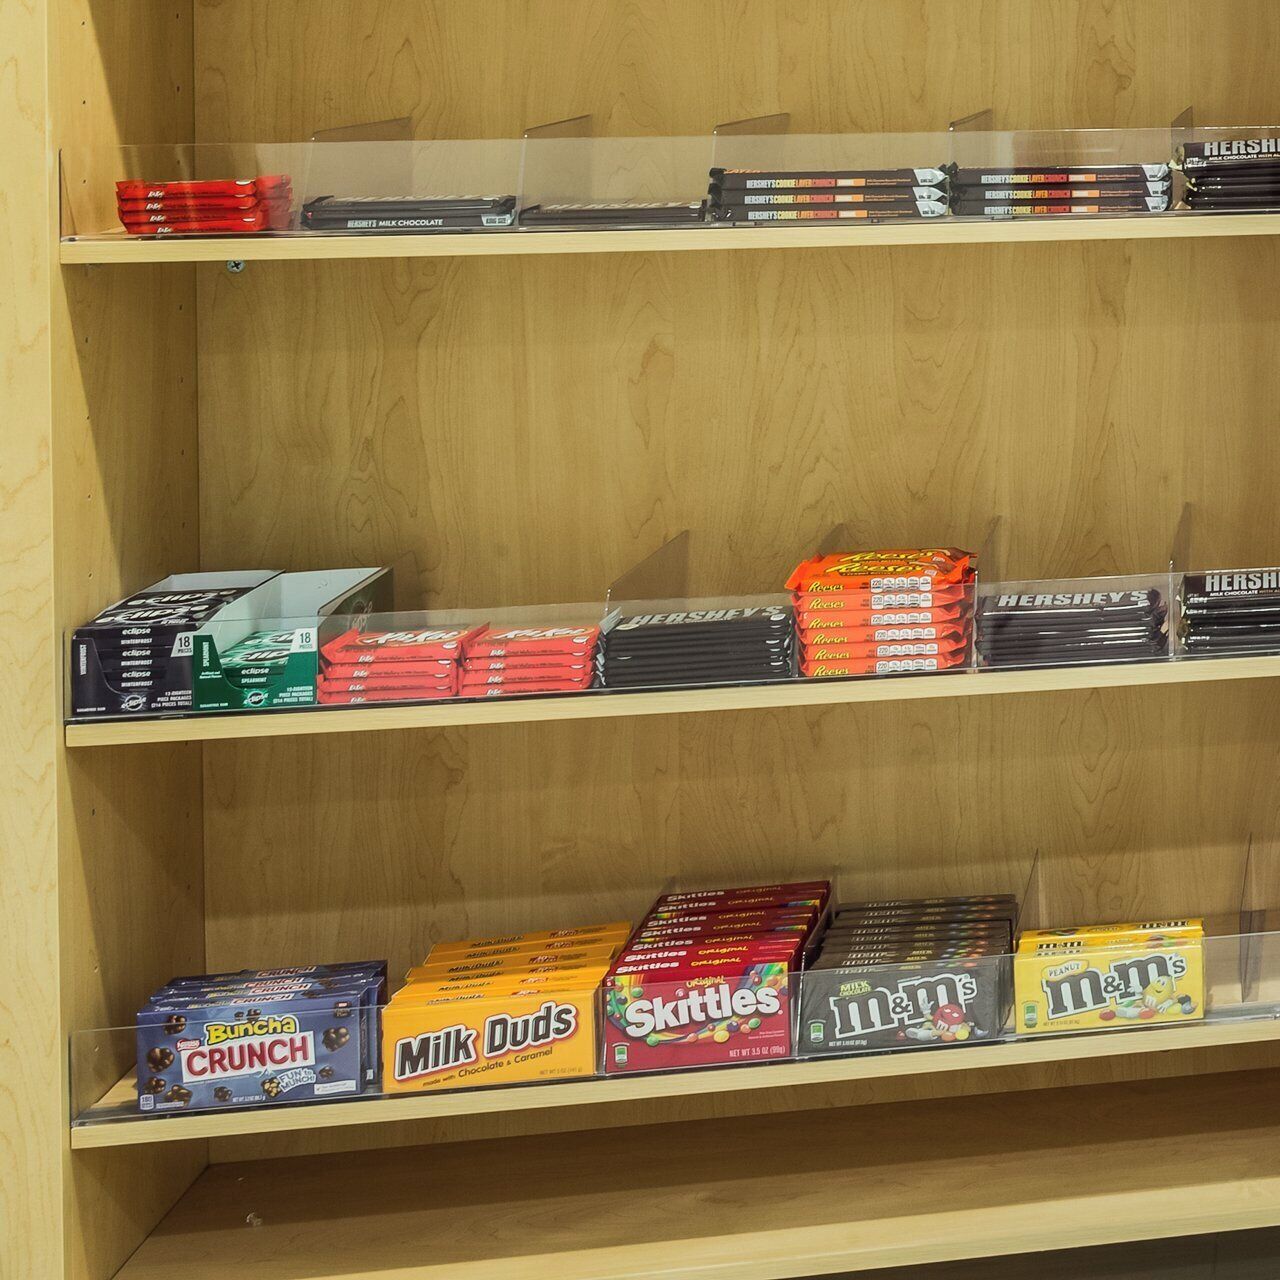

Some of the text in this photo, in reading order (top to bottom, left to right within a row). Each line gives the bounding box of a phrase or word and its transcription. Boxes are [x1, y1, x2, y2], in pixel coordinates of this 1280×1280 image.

[998, 591, 1148, 607] HERSHEY'S
[122, 627, 151, 636] eclipse
[300, 632, 311, 644] 18
[178, 636, 191, 648] 18
[122, 649, 151, 657] eclipse
[624, 950, 687, 962] Skittles
[616, 961, 679, 974] Skittles
[1049, 962, 1080, 977] PEANUT
[841, 981, 869, 991] MILK
[1042, 953, 1187, 1019] m&m's
[625, 986, 780, 1038] Skittles
[830, 973, 977, 1038] m&m's
[207, 1015, 297, 1044] Buncha
[397, 1003, 576, 1078] Milk Duds
[186, 1035, 310, 1078] CRUNCH
[458, 1046, 553, 1079] Chocolate Caramel
[282, 1074, 315, 1092] MUNCH!
